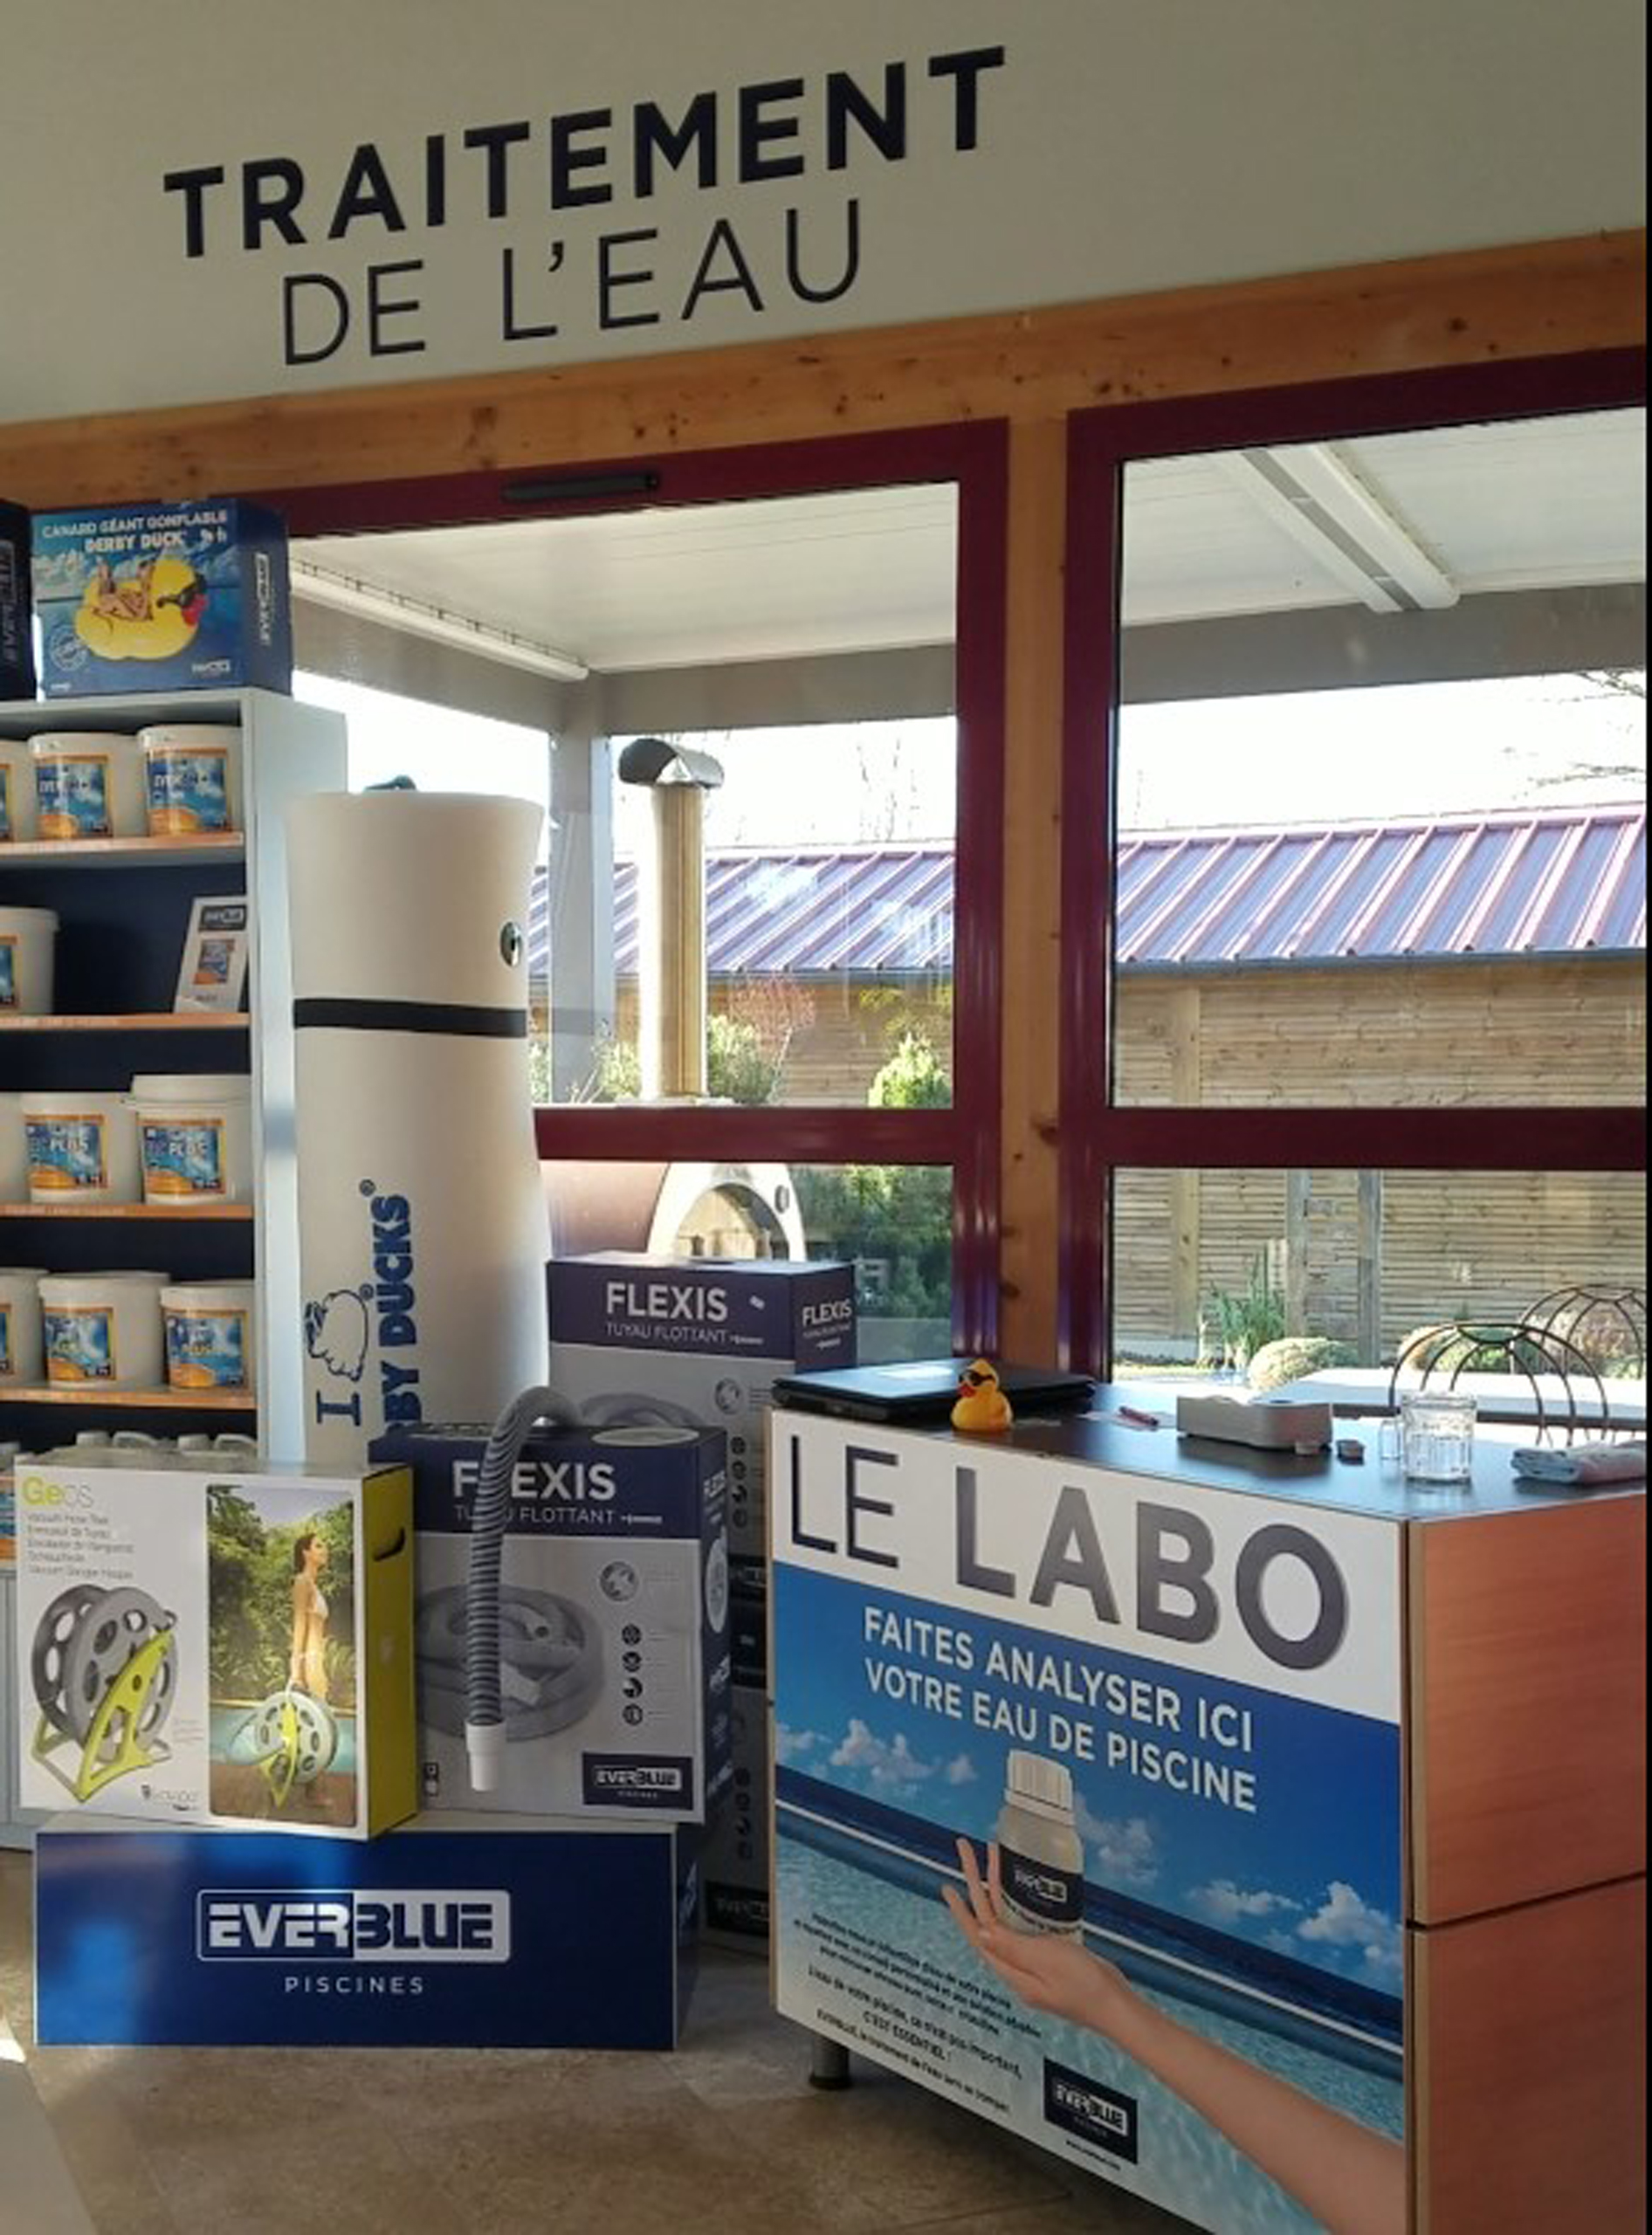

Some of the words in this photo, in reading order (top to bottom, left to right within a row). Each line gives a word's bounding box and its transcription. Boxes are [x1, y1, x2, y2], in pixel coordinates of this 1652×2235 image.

[164, 45, 1005, 258] TRAITEMENT
[283, 259, 426, 367] DE
[503, 198, 862, 341] L'EAU
[42, 522, 97, 539] CANARD
[147, 510, 227, 528] GONFLABLE
[85, 535, 135, 554] DERBY
[141, 531, 183, 549] DUCK
[370, 1194, 417, 1347] DUCKS
[606, 1282, 728, 1323] FLEXIS
[802, 1298, 852, 1327] FLEXIS
[606, 1322, 651, 1339] TUYAU
[653, 1325, 728, 1343] FLOTTANT
[453, 1461, 616, 1500] FEXIS
[520, 1506, 615, 1524] FLOTTANT
[791, 1434, 899, 1569] LE
[956, 1465, 1349, 1670] LABO
[864, 1606, 974, 1671] FAITES
[986, 1641, 1180, 1732] ANALYSER
[1198, 1696, 1252, 1753] ICI
[864, 1657, 963, 1720] VOTRE
[973, 1690, 1037, 1742] EAU
[1050, 1713, 1096, 1762] DE
[1107, 1730, 1256, 1813] PISCINE
[208, 1902, 493, 1950] EVERBLUE
[284, 1976, 425, 1995] PISCINES
